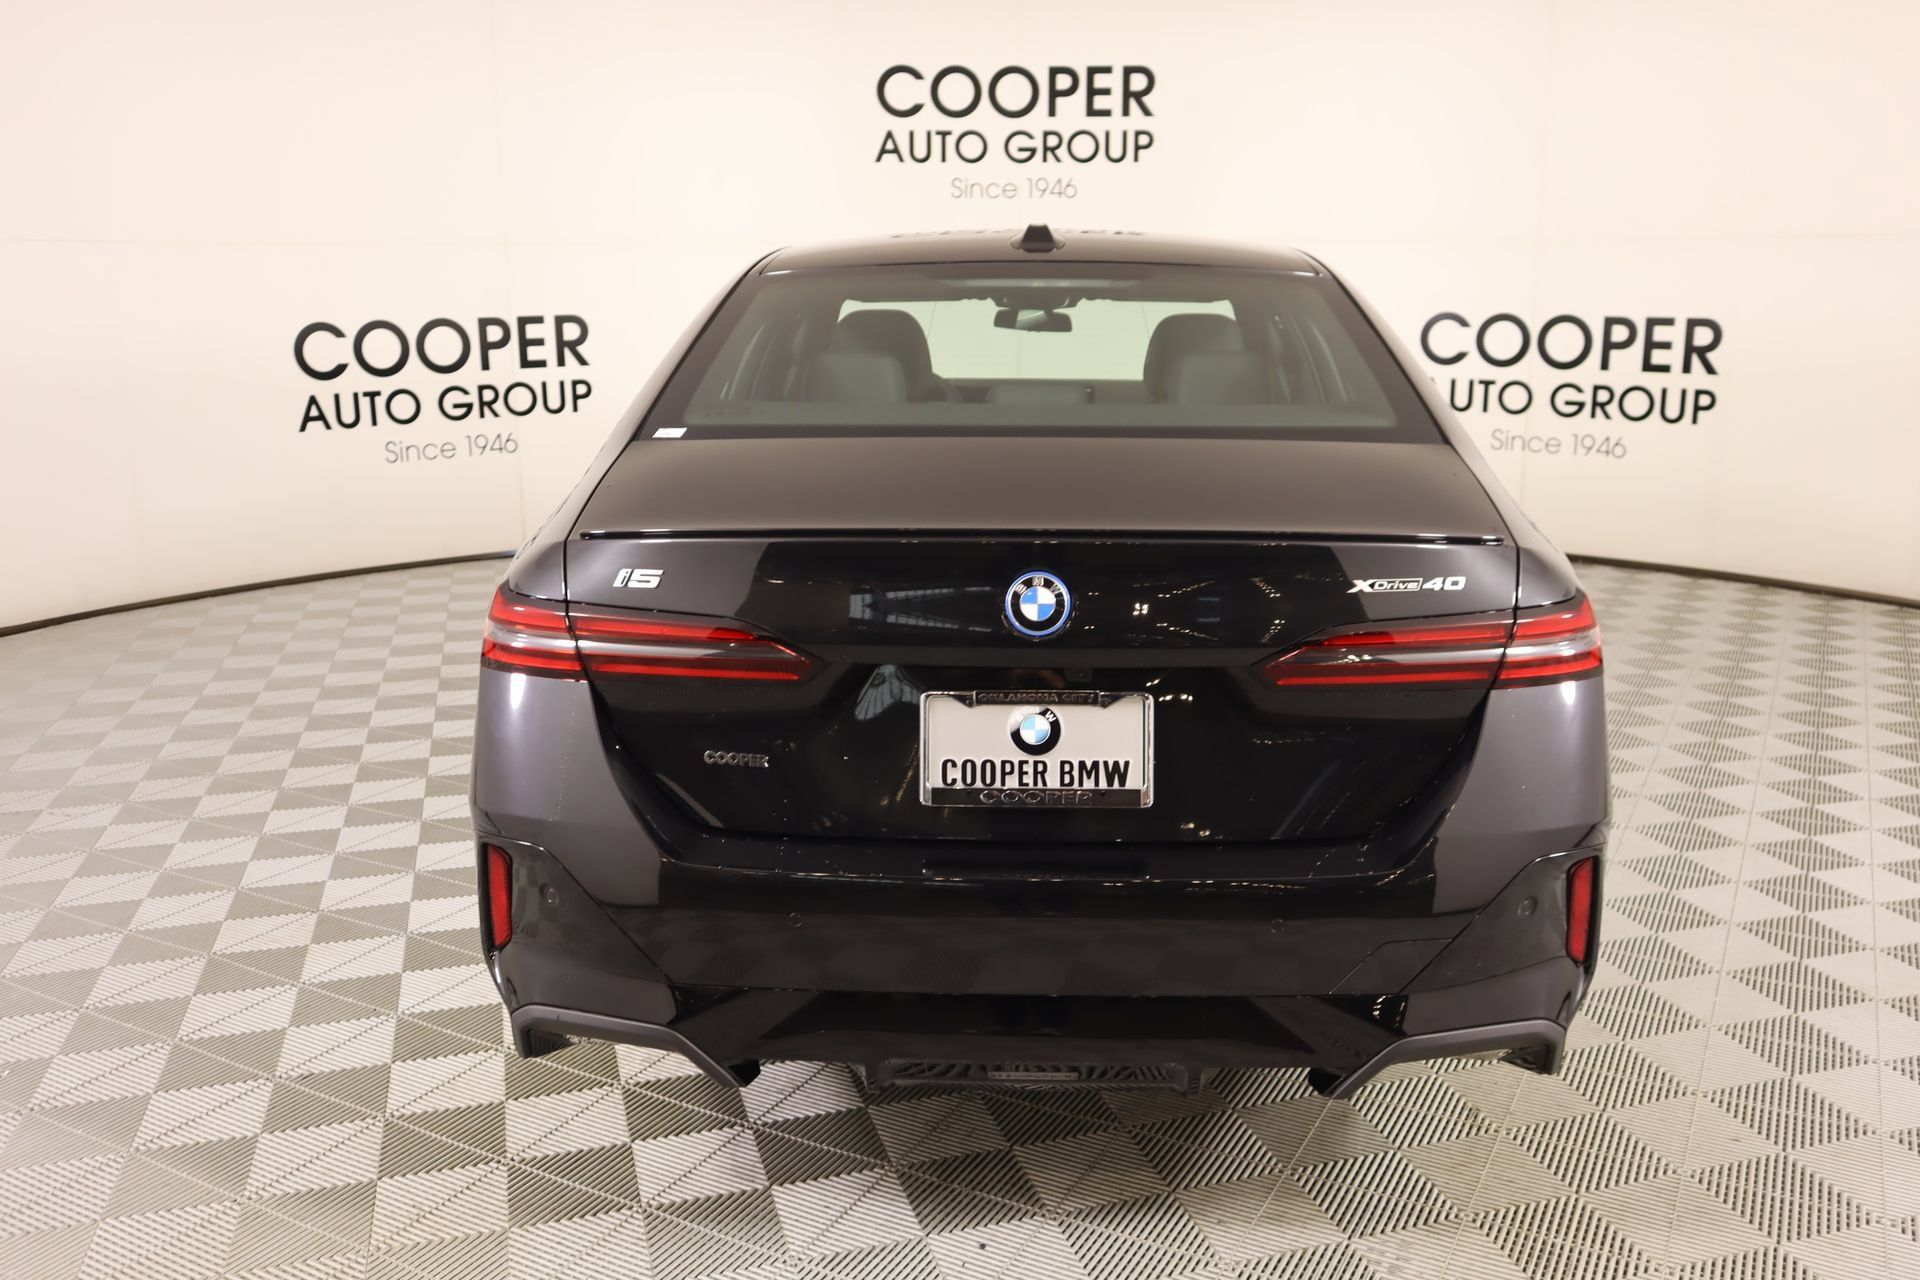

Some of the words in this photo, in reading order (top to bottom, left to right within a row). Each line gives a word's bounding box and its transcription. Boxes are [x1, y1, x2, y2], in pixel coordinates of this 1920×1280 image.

[877, 65, 1155, 118] COOPER
[875, 130, 988, 163] AUTO
[1004, 130, 1154, 163] GROUP
[951, 177, 1018, 198] Since
[1027, 177, 1078, 199] 1946
[294, 315, 590, 381] COOPER
[1420, 312, 1723, 375] COOPER
[299, 388, 421, 432] AUTO
[438, 379, 592, 421] GROUP
[1450, 378, 1533, 415] UTO
[1550, 383, 1717, 425] GROUP
[384, 440, 457, 464] Since
[465, 432, 519, 457] 1946
[1490, 428, 1562, 454] Since
[1572, 433, 1627, 459] 1946
[612, 568, 664, 589] i5
[704, 750, 769, 768] COOPER
[941, 758, 1048, 788] COOPER
[1059, 760, 1130, 788] BMW
[979, 790, 1093, 805] COOPER
